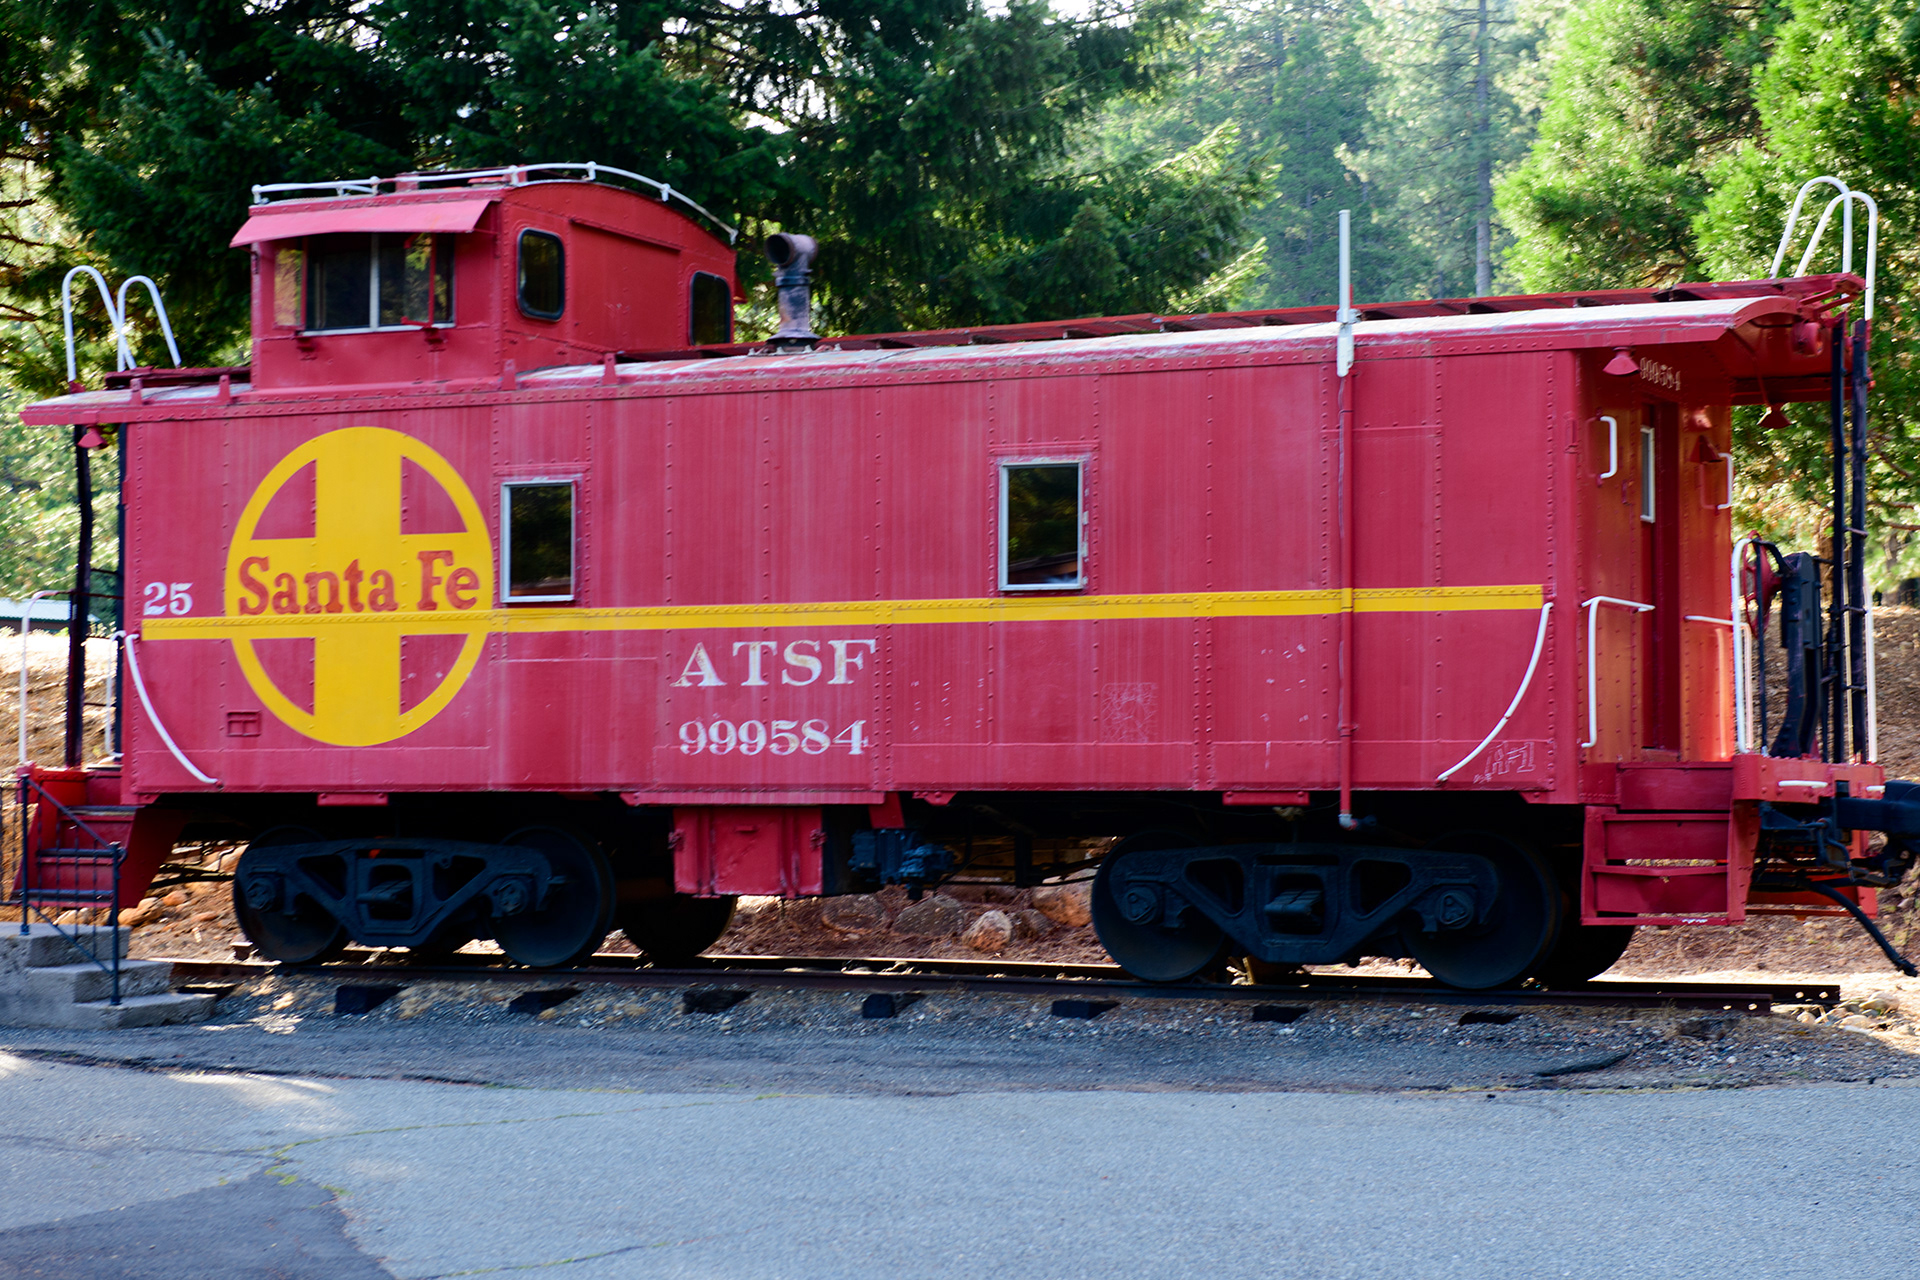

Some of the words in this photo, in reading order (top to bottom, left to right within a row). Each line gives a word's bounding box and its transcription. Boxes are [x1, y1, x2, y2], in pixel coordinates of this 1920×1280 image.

[1640, 357, 1681, 391] 999584
[143, 582, 193, 615] 25
[238, 556, 398, 616] Santa
[416, 550, 481, 610] Fe
[670, 639, 876, 687] ATSF
[678, 718, 869, 756] 999584
